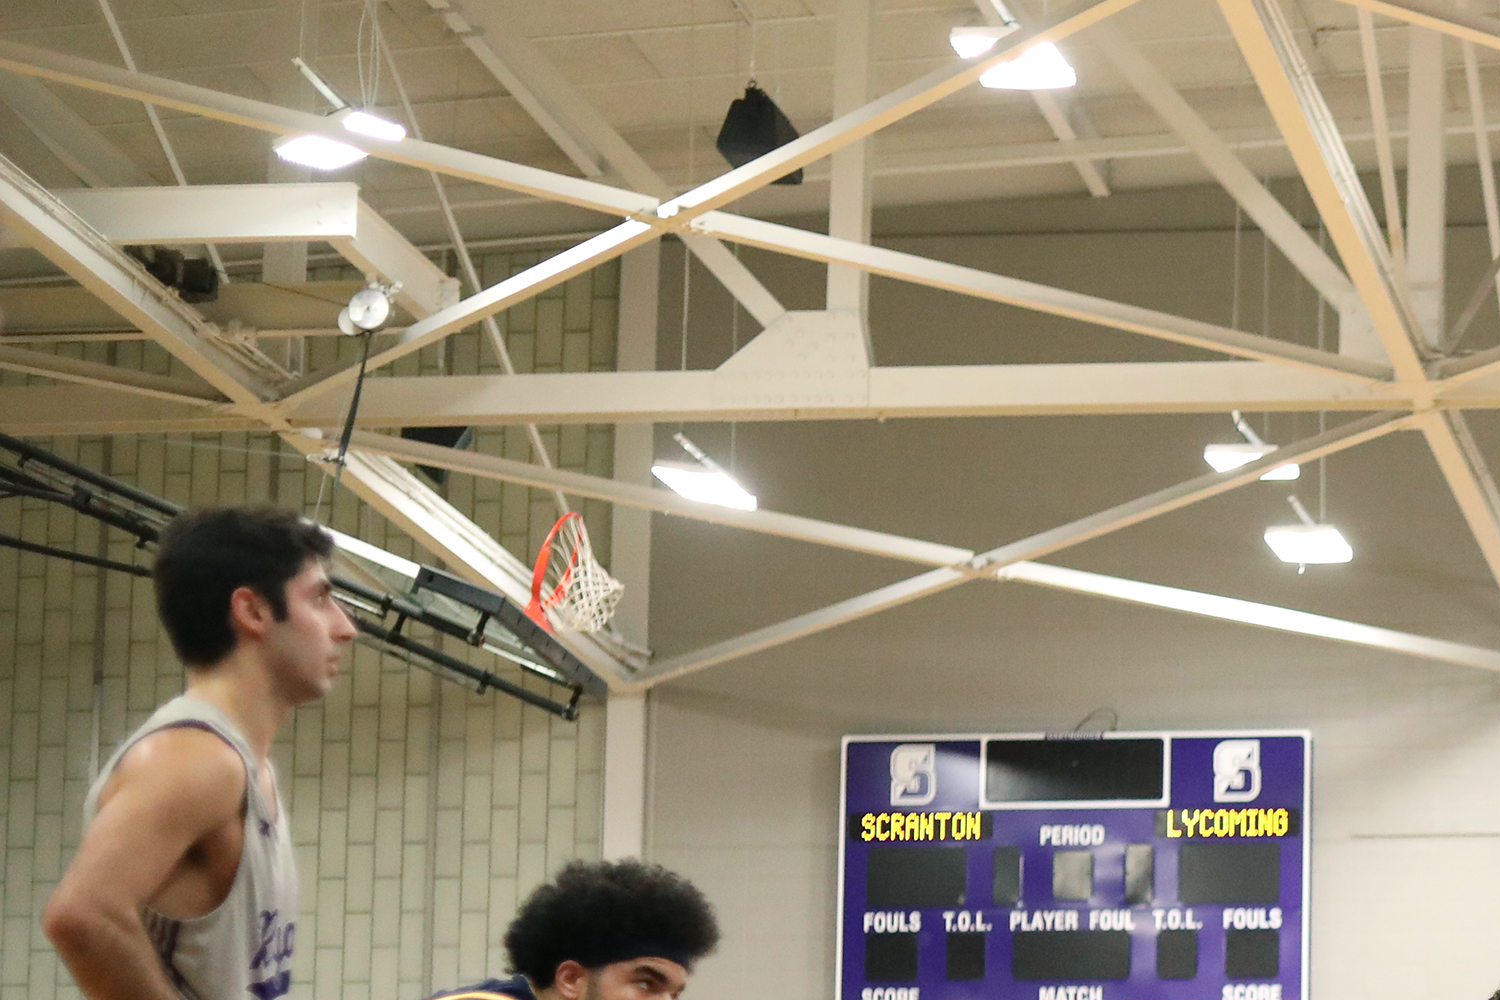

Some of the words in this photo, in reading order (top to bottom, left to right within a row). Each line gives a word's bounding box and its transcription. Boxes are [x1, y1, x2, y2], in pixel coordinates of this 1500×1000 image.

[861, 811, 981, 841] SCRANTON
[1166, 808, 1289, 838] LYCOMING
[1039, 824, 1106, 846] PERIOD
[863, 911, 922, 934] FOULS
[942, 910, 993, 932] T.O.L.
[1009, 909, 1079, 932] PLAYER
[1089, 909, 1136, 931] FOUL
[1152, 908, 1203, 930] T.O.L.
[1222, 907, 1283, 930] FOULS
